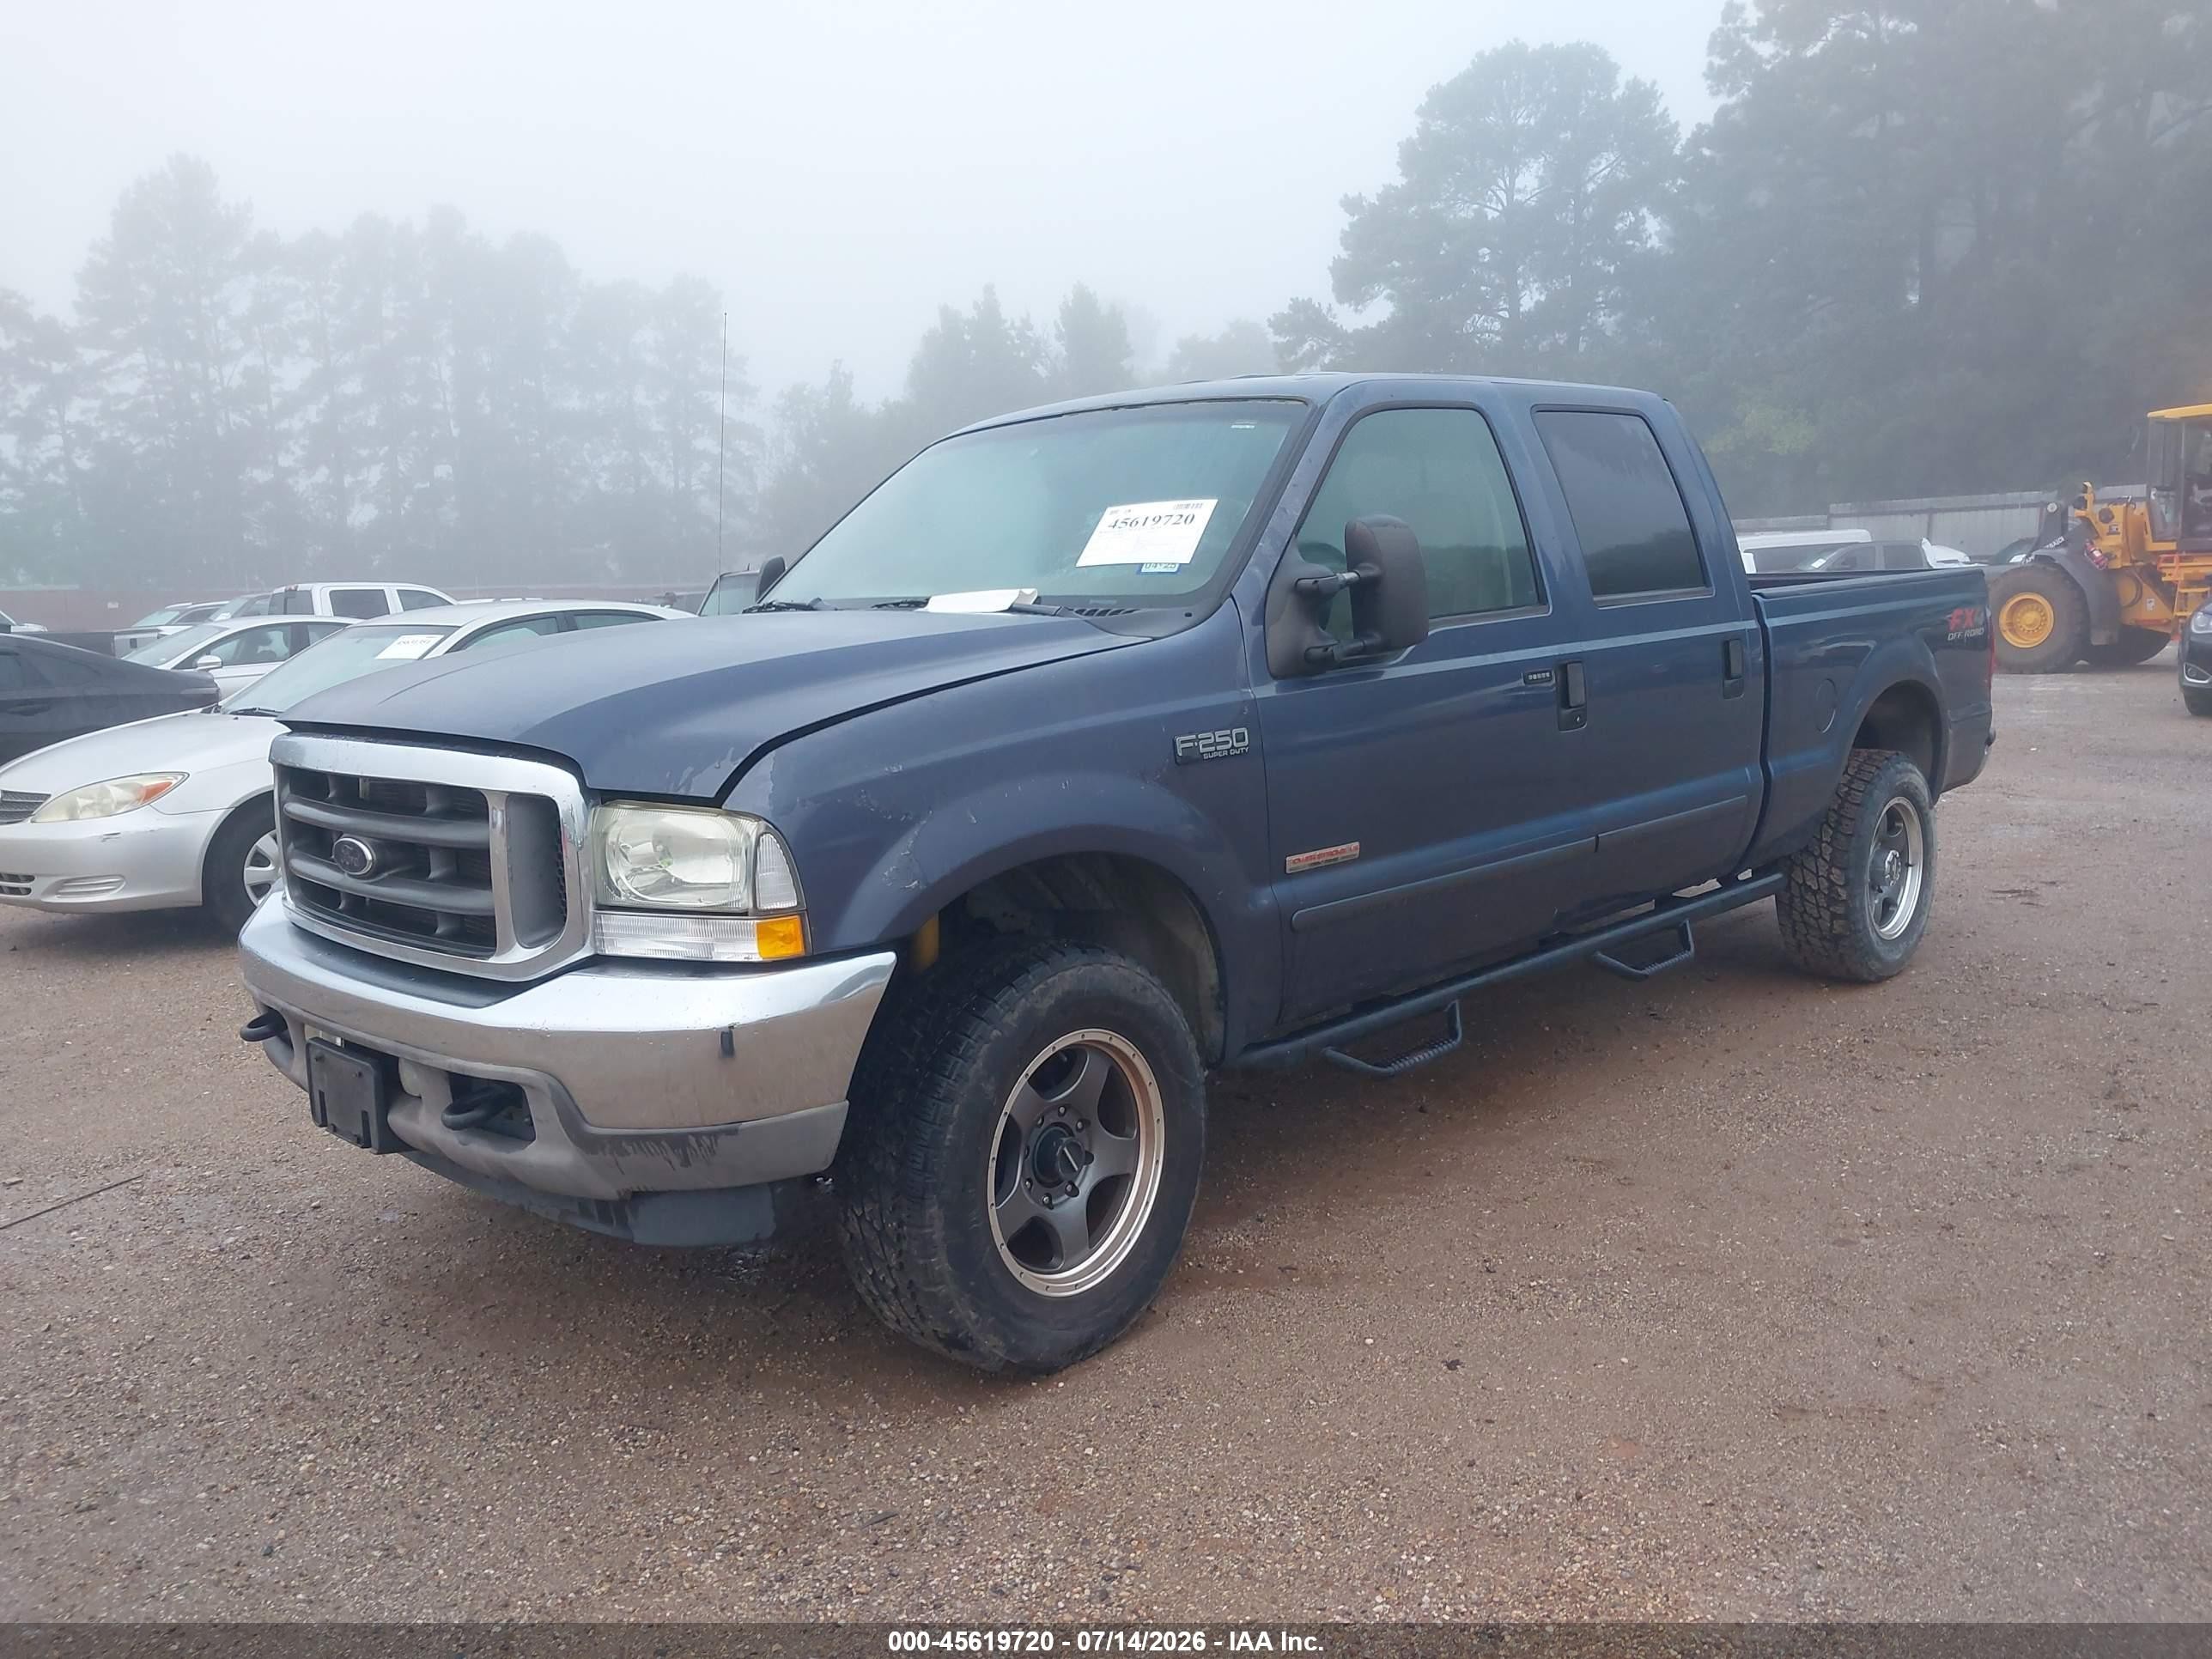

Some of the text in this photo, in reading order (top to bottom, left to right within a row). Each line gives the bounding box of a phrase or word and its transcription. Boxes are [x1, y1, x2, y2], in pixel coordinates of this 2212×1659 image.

[1108, 514, 1196, 529] 45619720
[1948, 632, 1963, 641] OFF
[1230, 747, 1249, 756] DUTY
